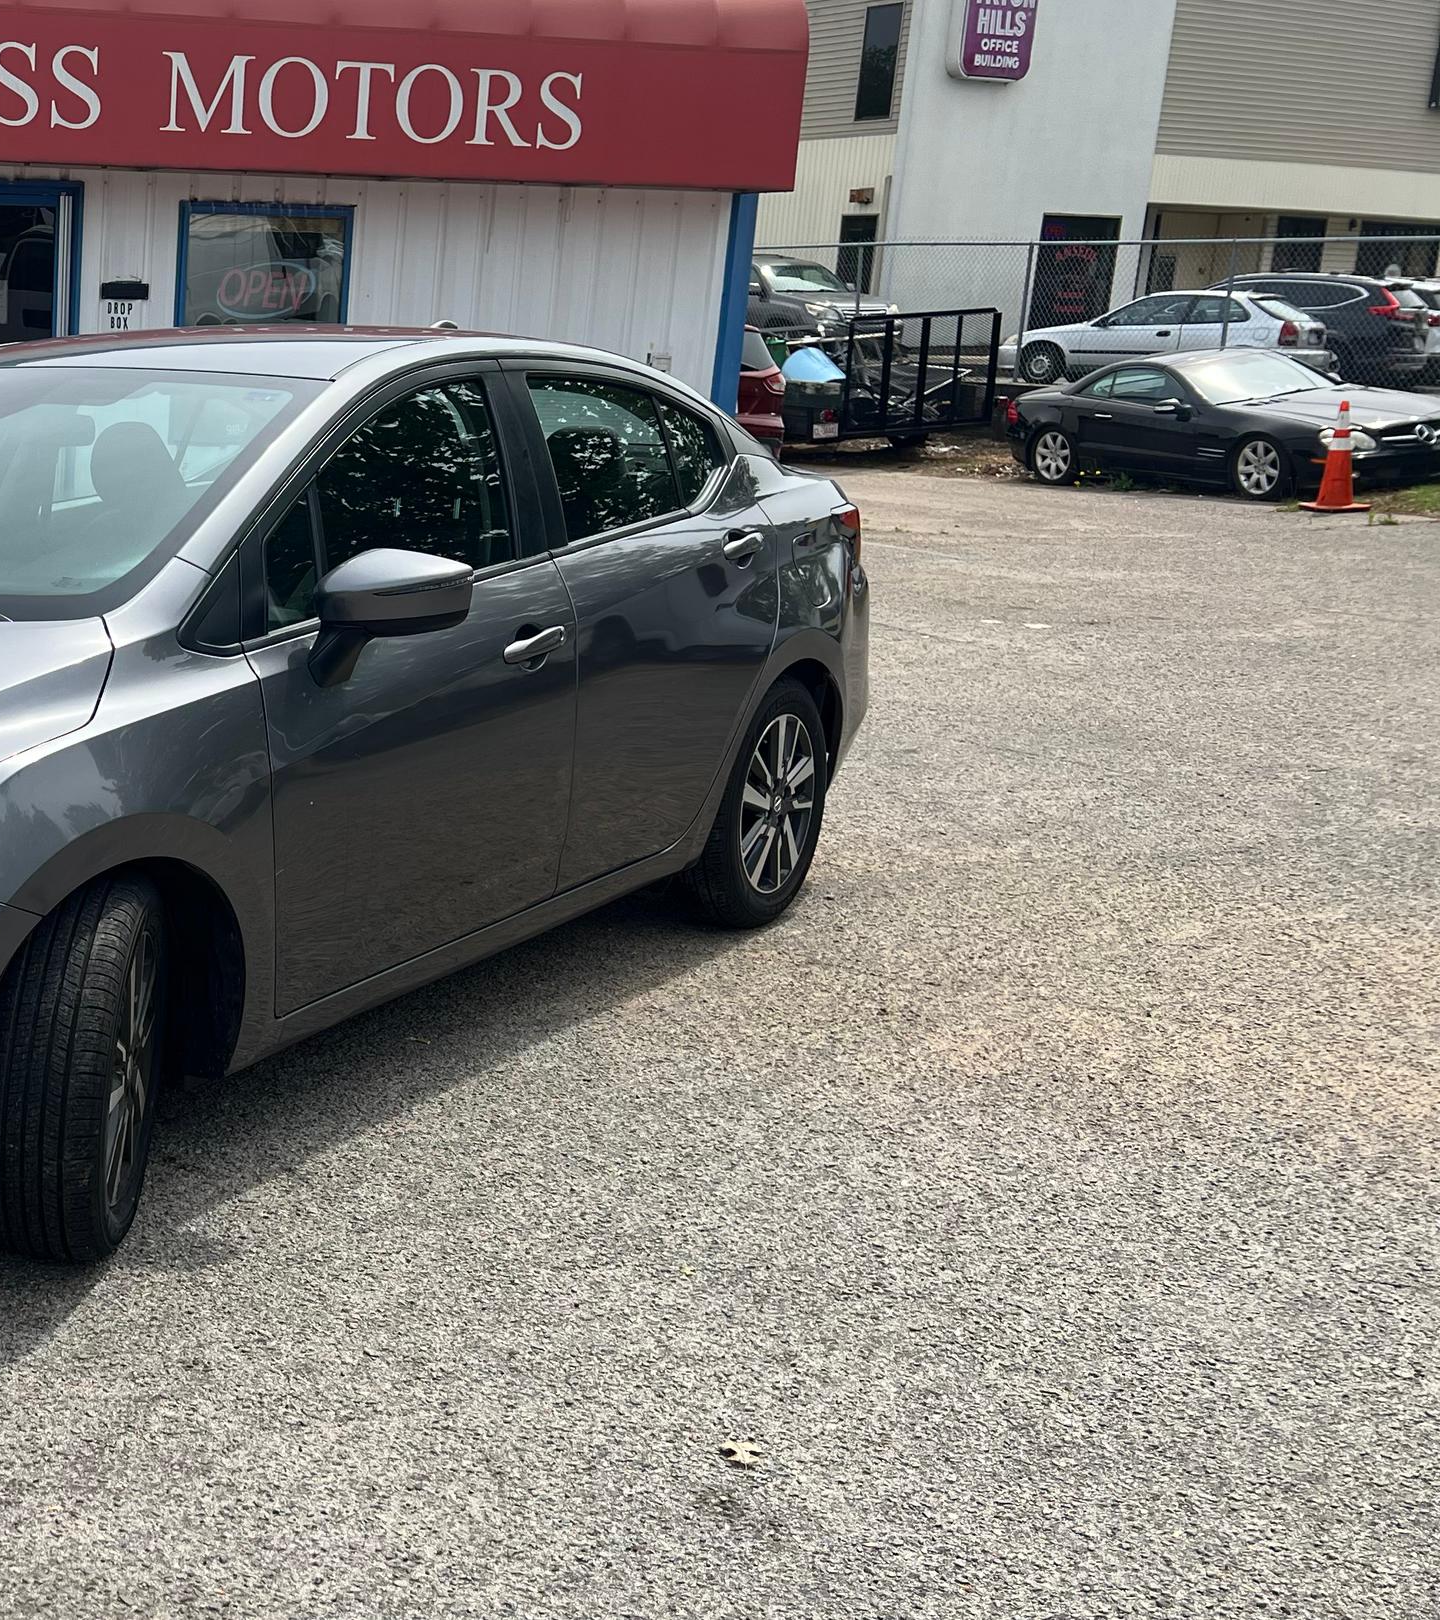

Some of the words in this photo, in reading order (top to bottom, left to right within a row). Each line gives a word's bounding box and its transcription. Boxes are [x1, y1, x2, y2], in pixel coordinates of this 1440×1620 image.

[976, 8, 1026, 37] HILLS
[981, 38, 1019, 53] OFFICE
[973, 53, 1020, 69] BUILDING
[159, 51, 583, 150] MOTORS
[220, 267, 308, 311] OPEN
[107, 301, 133, 315] DROP
[110, 316, 129, 331] BOX
